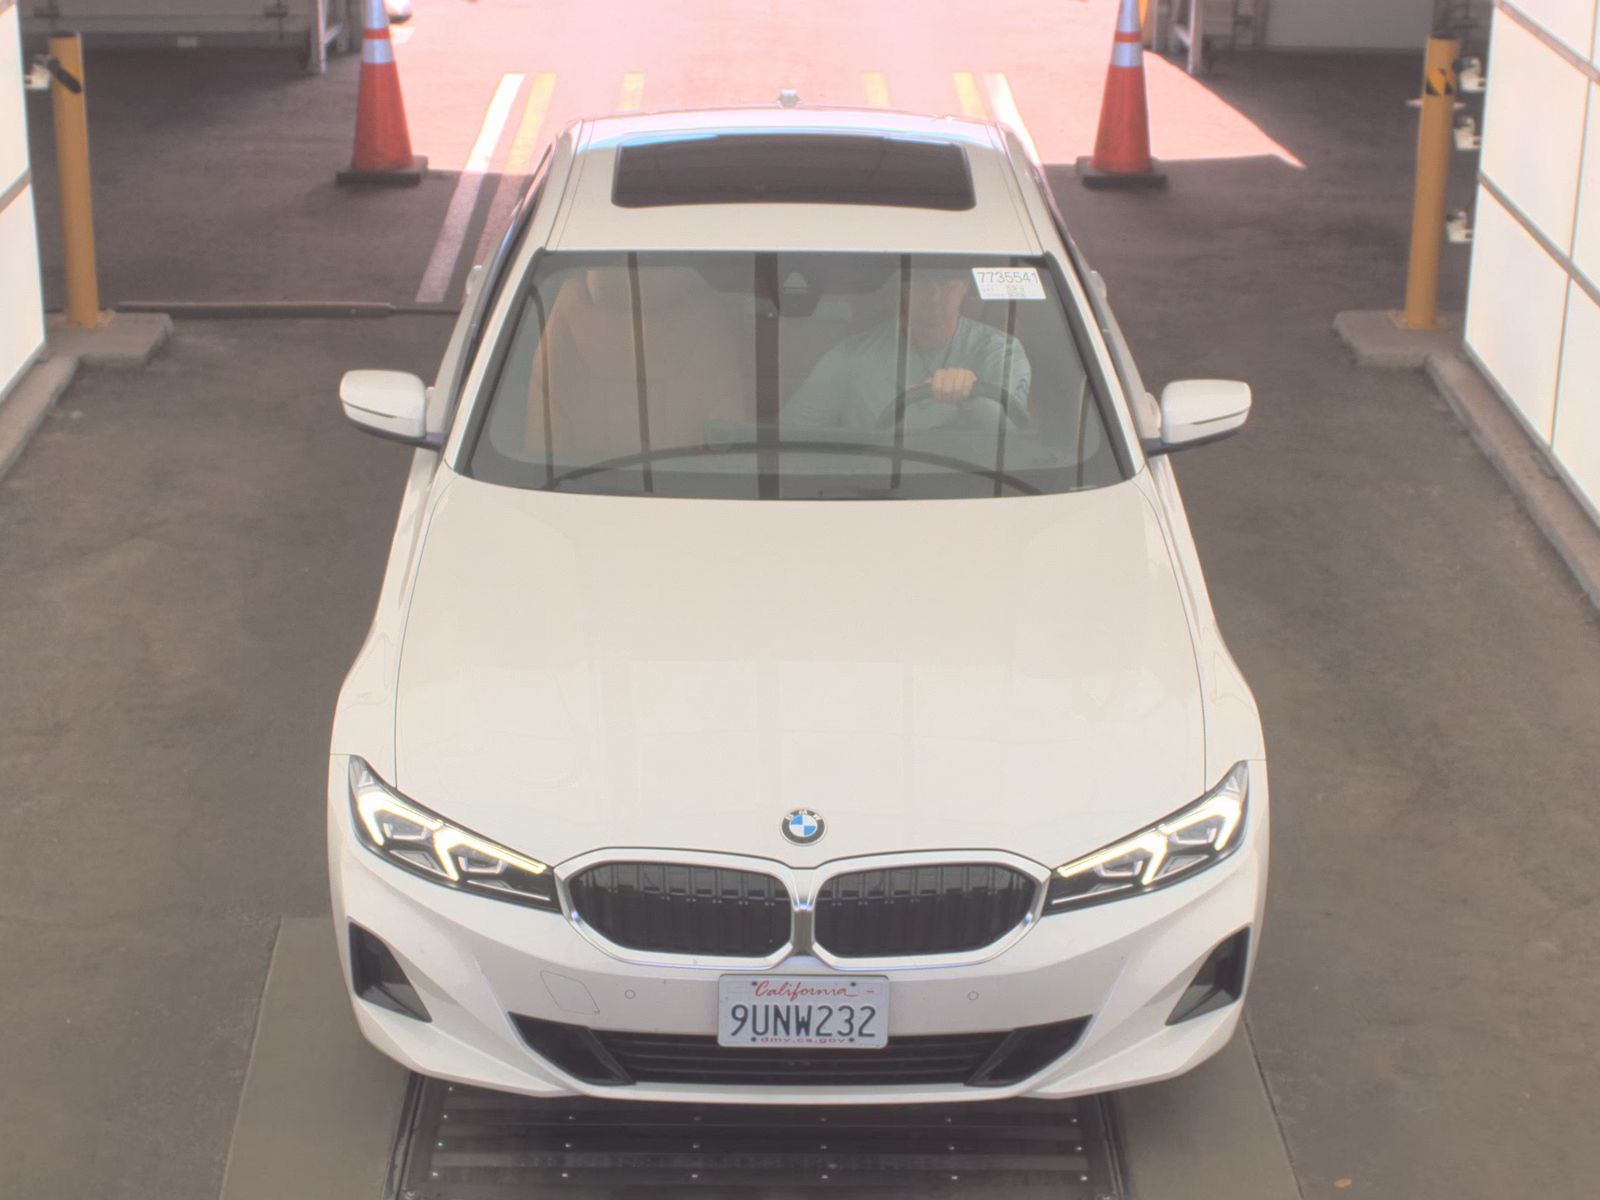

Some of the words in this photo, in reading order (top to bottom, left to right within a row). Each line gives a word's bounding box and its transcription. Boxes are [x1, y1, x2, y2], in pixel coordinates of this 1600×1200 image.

[976, 271, 1039, 284] 7735541
[755, 979, 859, 1001] California
[730, 1004, 876, 1037] 9UNW232
[760, 1036, 846, 1044] dmv.ca.gov
